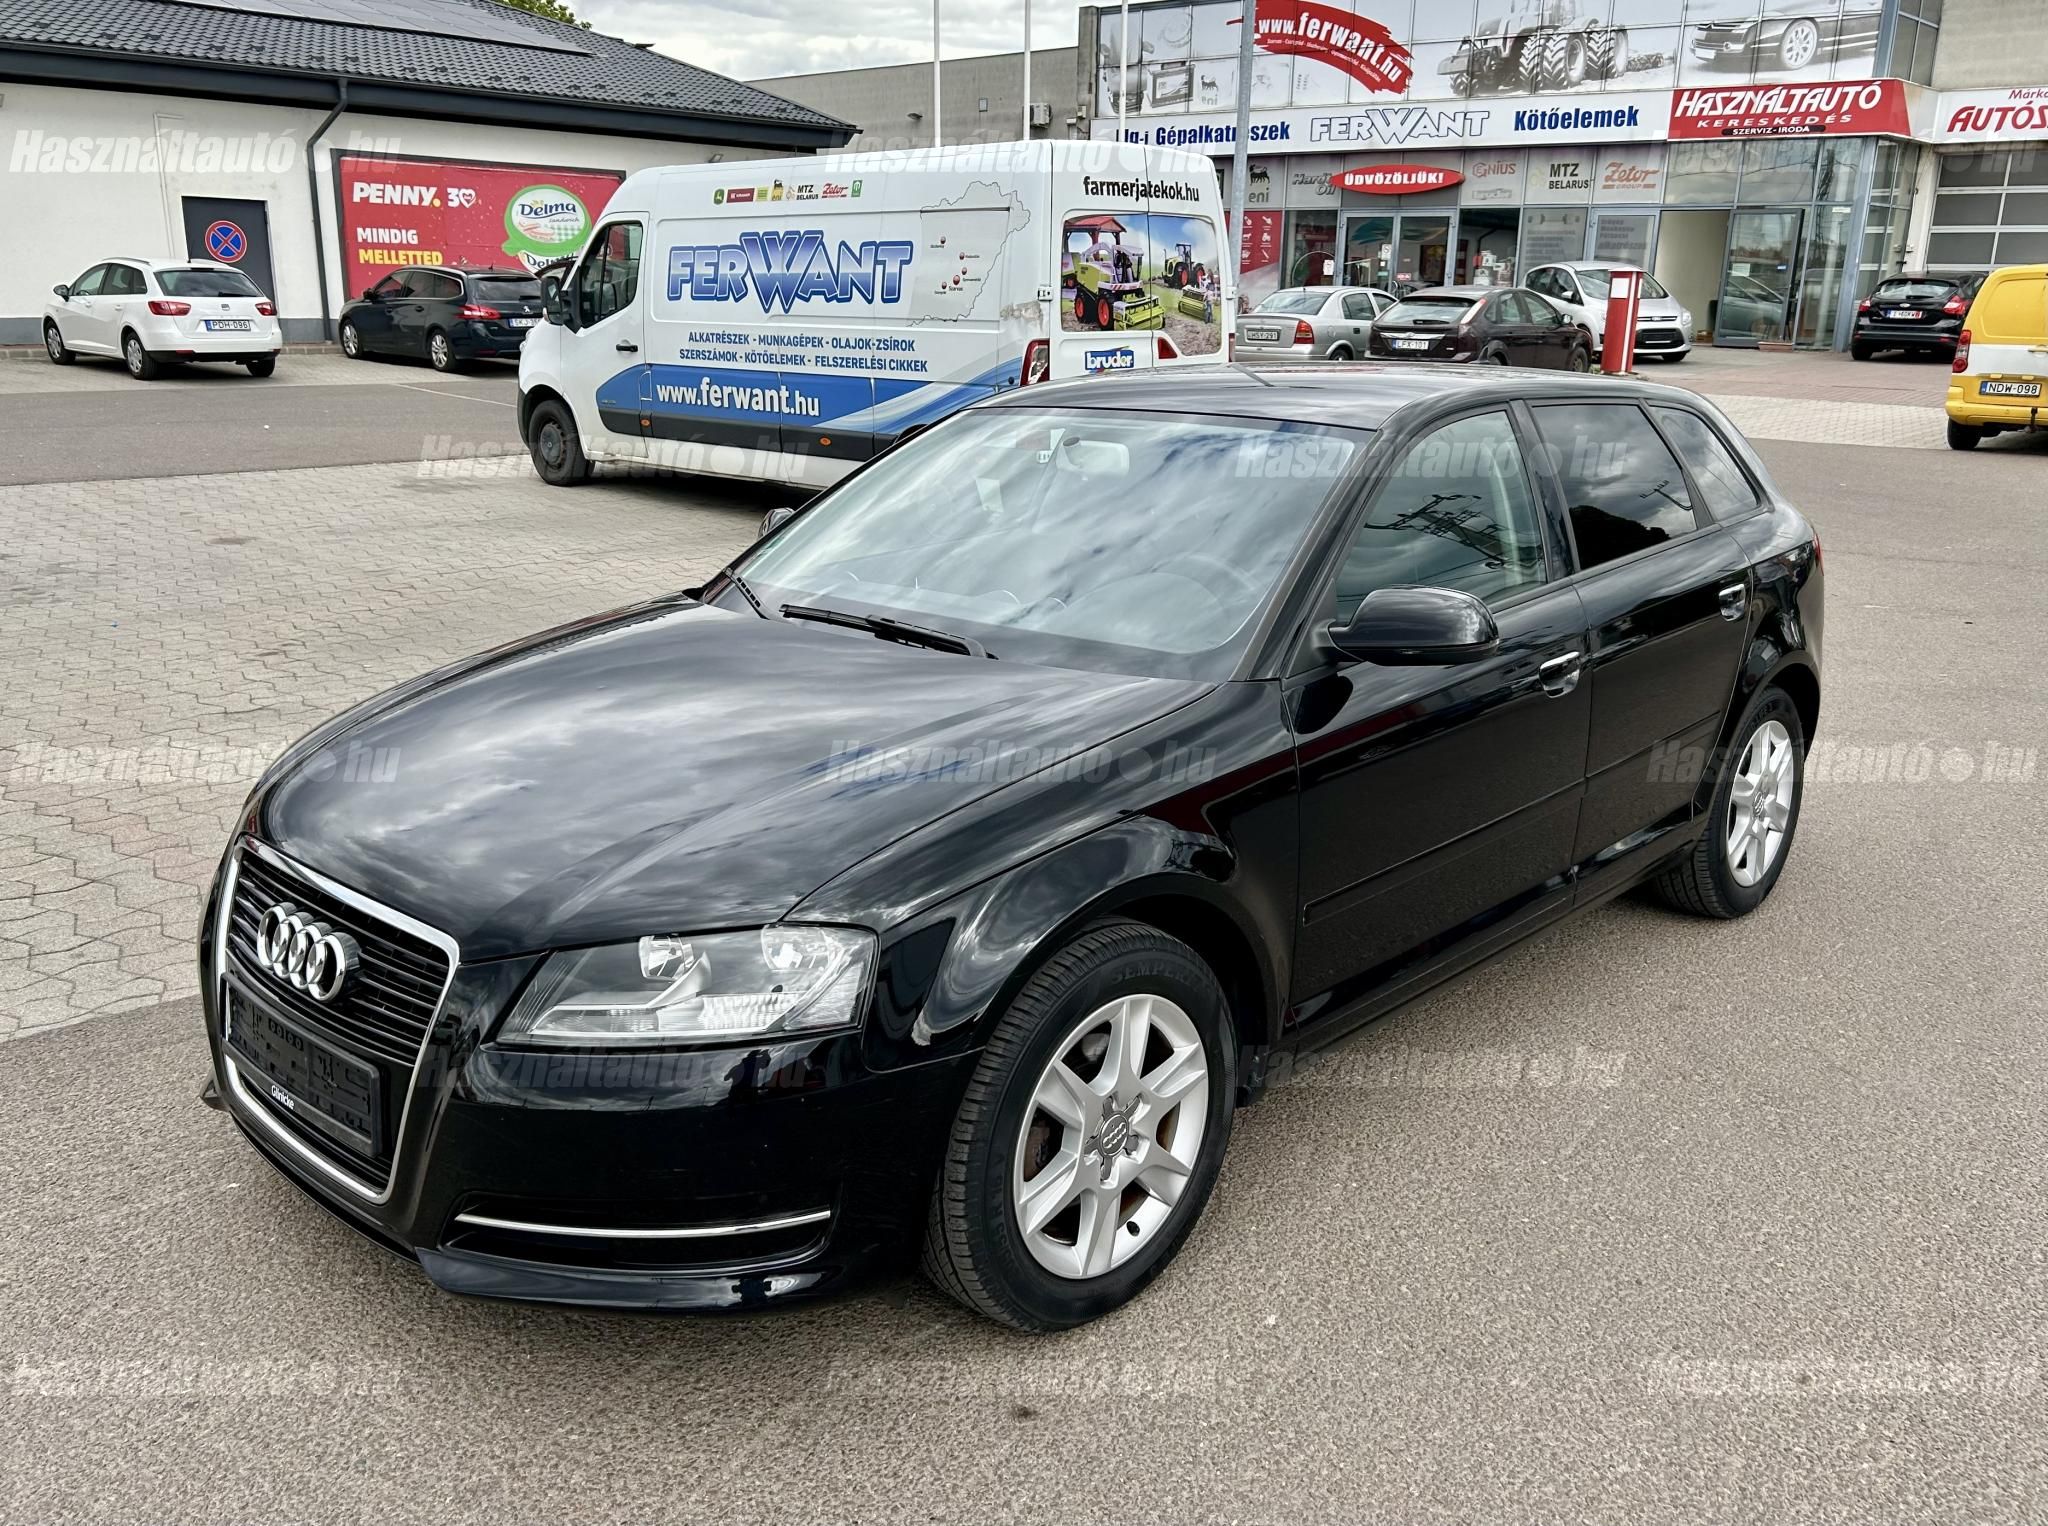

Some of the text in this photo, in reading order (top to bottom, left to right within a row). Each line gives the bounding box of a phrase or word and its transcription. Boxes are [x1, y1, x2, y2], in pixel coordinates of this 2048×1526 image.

[1258, 12, 1403, 83] www.ferwant.hu
[1674, 81, 1882, 118] HASZNÁLTAUTÓ
[1513, 105, 1640, 132] Kötőelemek
[1697, 113, 1853, 128] KERESKEDÉS
[1946, 100, 2048, 133] AUTÓS
[1156, 121, 1290, 146] Gépalkatrszek
[1310, 107, 1490, 145] FERWANT
[1344, 171, 1444, 186] ÜDVÖZÖLJÜK!
[1550, 162, 1580, 177] MTZ
[797, 184, 814, 194] MTZ
[1083, 176, 1200, 202] farmerjatekok.hu
[1549, 179, 1589, 190] BELARUS
[1249, 188, 1270, 203] eni
[519, 202, 577, 218] Delma
[357, 227, 418, 245] MINDIG
[359, 248, 443, 266] MELLETTED
[667, 230, 914, 314] FERWANT
[688, 330, 750, 345] ALKATRÉSZEK
[758, 333, 824, 348] MUNKAGÉPEK
[679, 347, 928, 373] SZERSZÁMOK KÖTŐELEMEK FELSZERELÉSI CIKKEK
[1086, 351, 1133, 369] bruder
[656, 377, 820, 417] www.ferwant.hu
[1987, 383, 2038, 395] NDW-098
